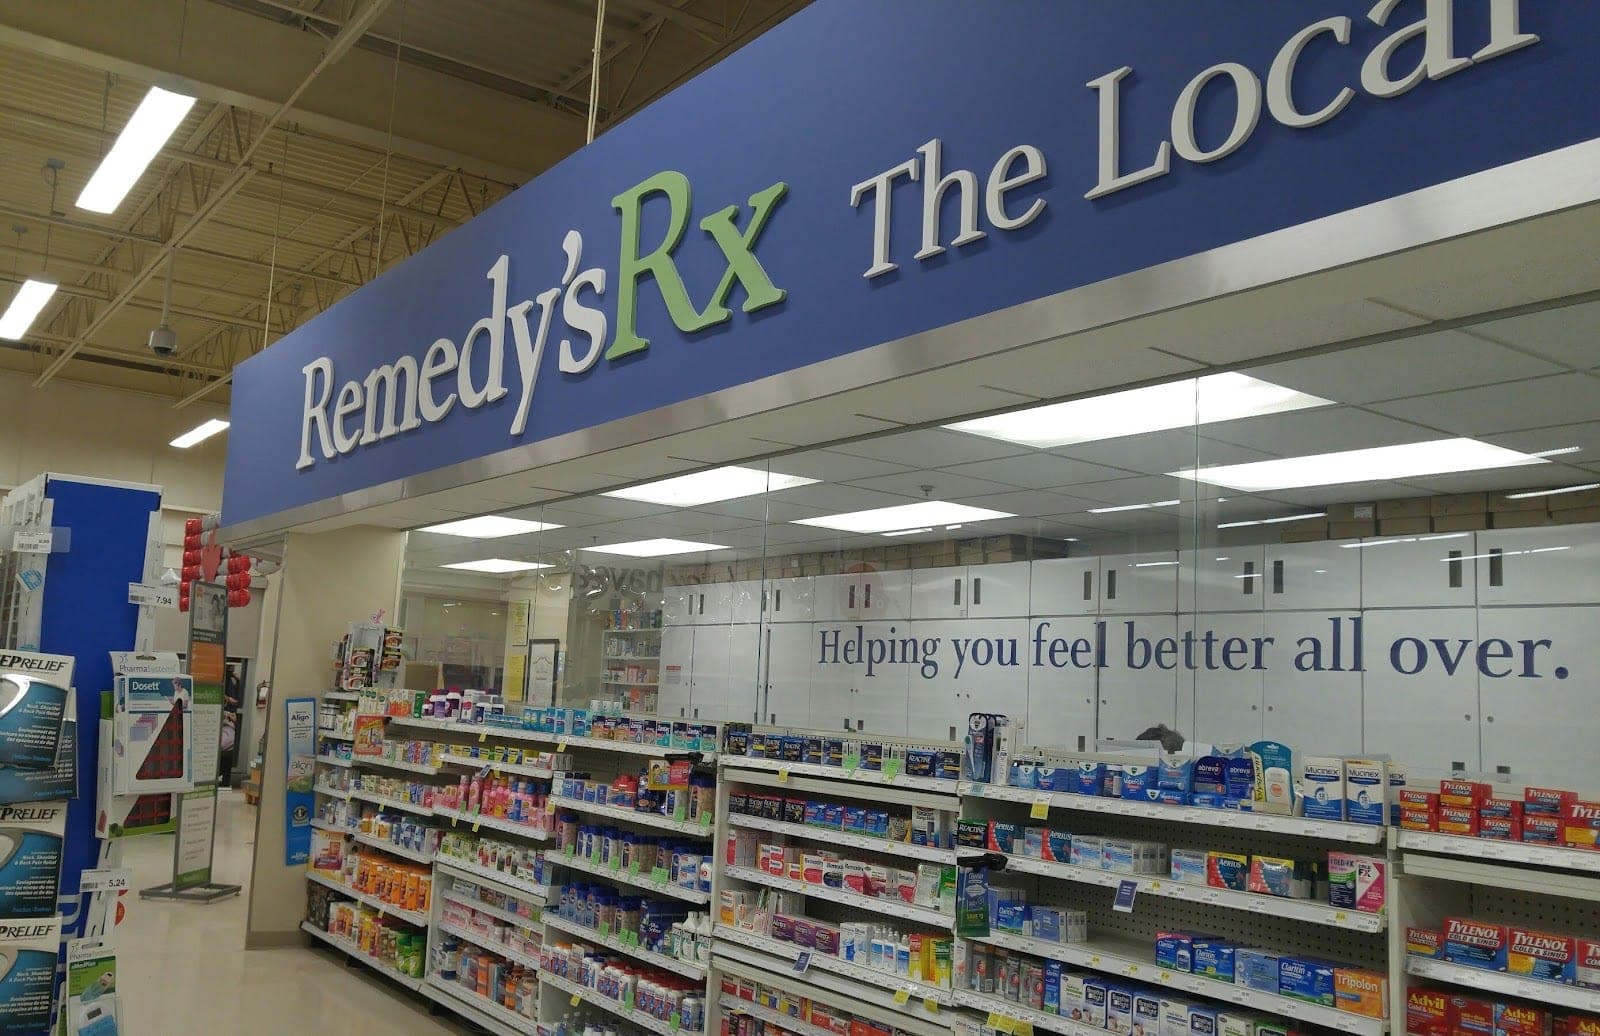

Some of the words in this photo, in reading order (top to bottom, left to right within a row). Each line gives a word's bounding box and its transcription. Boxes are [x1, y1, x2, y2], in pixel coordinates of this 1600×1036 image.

[849, 138, 1048, 279] The
[155, 595, 172, 605] 7.94
[818, 626, 942, 679] Helping
[950, 636, 1020, 679] you
[1032, 621, 1109, 668] feel
[1124, 620, 1275, 671] better
[1294, 616, 1367, 672] all
[1389, 635, 1569, 679] over.
[132, 681, 161, 691] Dosett
[291, 713, 310, 722] Align
[1442, 781, 1472, 792] TYLENOL
[1528, 789, 1562, 800] TYLENOL
[1442, 808, 1472, 819] TYLENOL
[1526, 817, 1558, 828] TYLENOL
[1358, 869, 1372, 878] FX
[108, 878, 126, 887] 5.24
[1409, 930, 1438, 942] TYLENOL
[1448, 920, 1500, 940] TYLENOL
[1449, 932, 1467, 941] COLD
[1469, 935, 1476, 943] &
[1476, 937, 1499, 947] SINUS
[1514, 931, 1568, 952] TYLENOL
[1514, 944, 1533, 954] COLD
[1541, 949, 1567, 960] SINUS
[1281, 962, 1306, 975] Claritin
[1336, 972, 1379, 993] Tripolon
[1409, 993, 1446, 1010] Advil
[1503, 1007, 1536, 1022] Advil
